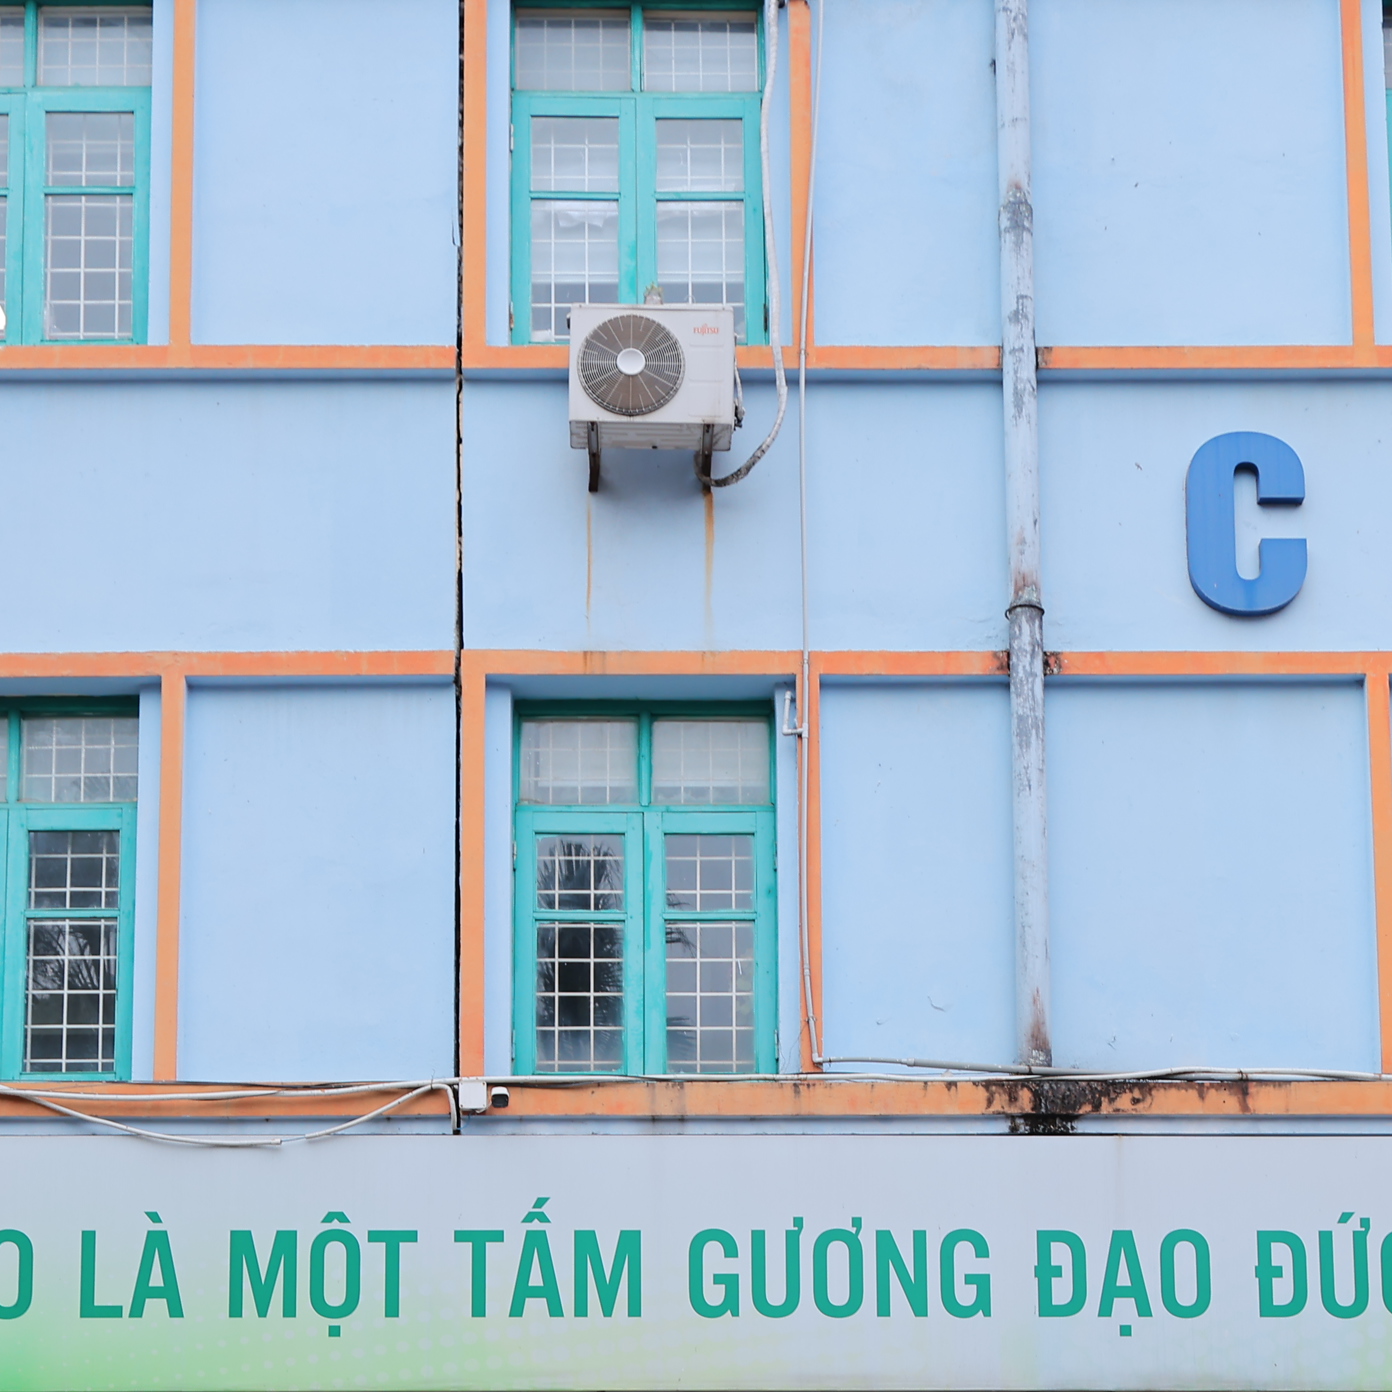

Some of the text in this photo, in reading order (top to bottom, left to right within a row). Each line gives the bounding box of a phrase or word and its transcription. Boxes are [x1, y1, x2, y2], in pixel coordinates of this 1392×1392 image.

[1185, 431, 1308, 617] C
[80, 1212, 184, 1318] LÀ
[229, 1212, 418, 1337] MỘT
[454, 1197, 641, 1317] TẤM
[689, 1217, 991, 1318] GƯƠNG
[1034, 1229, 1211, 1336] ĐẠO
